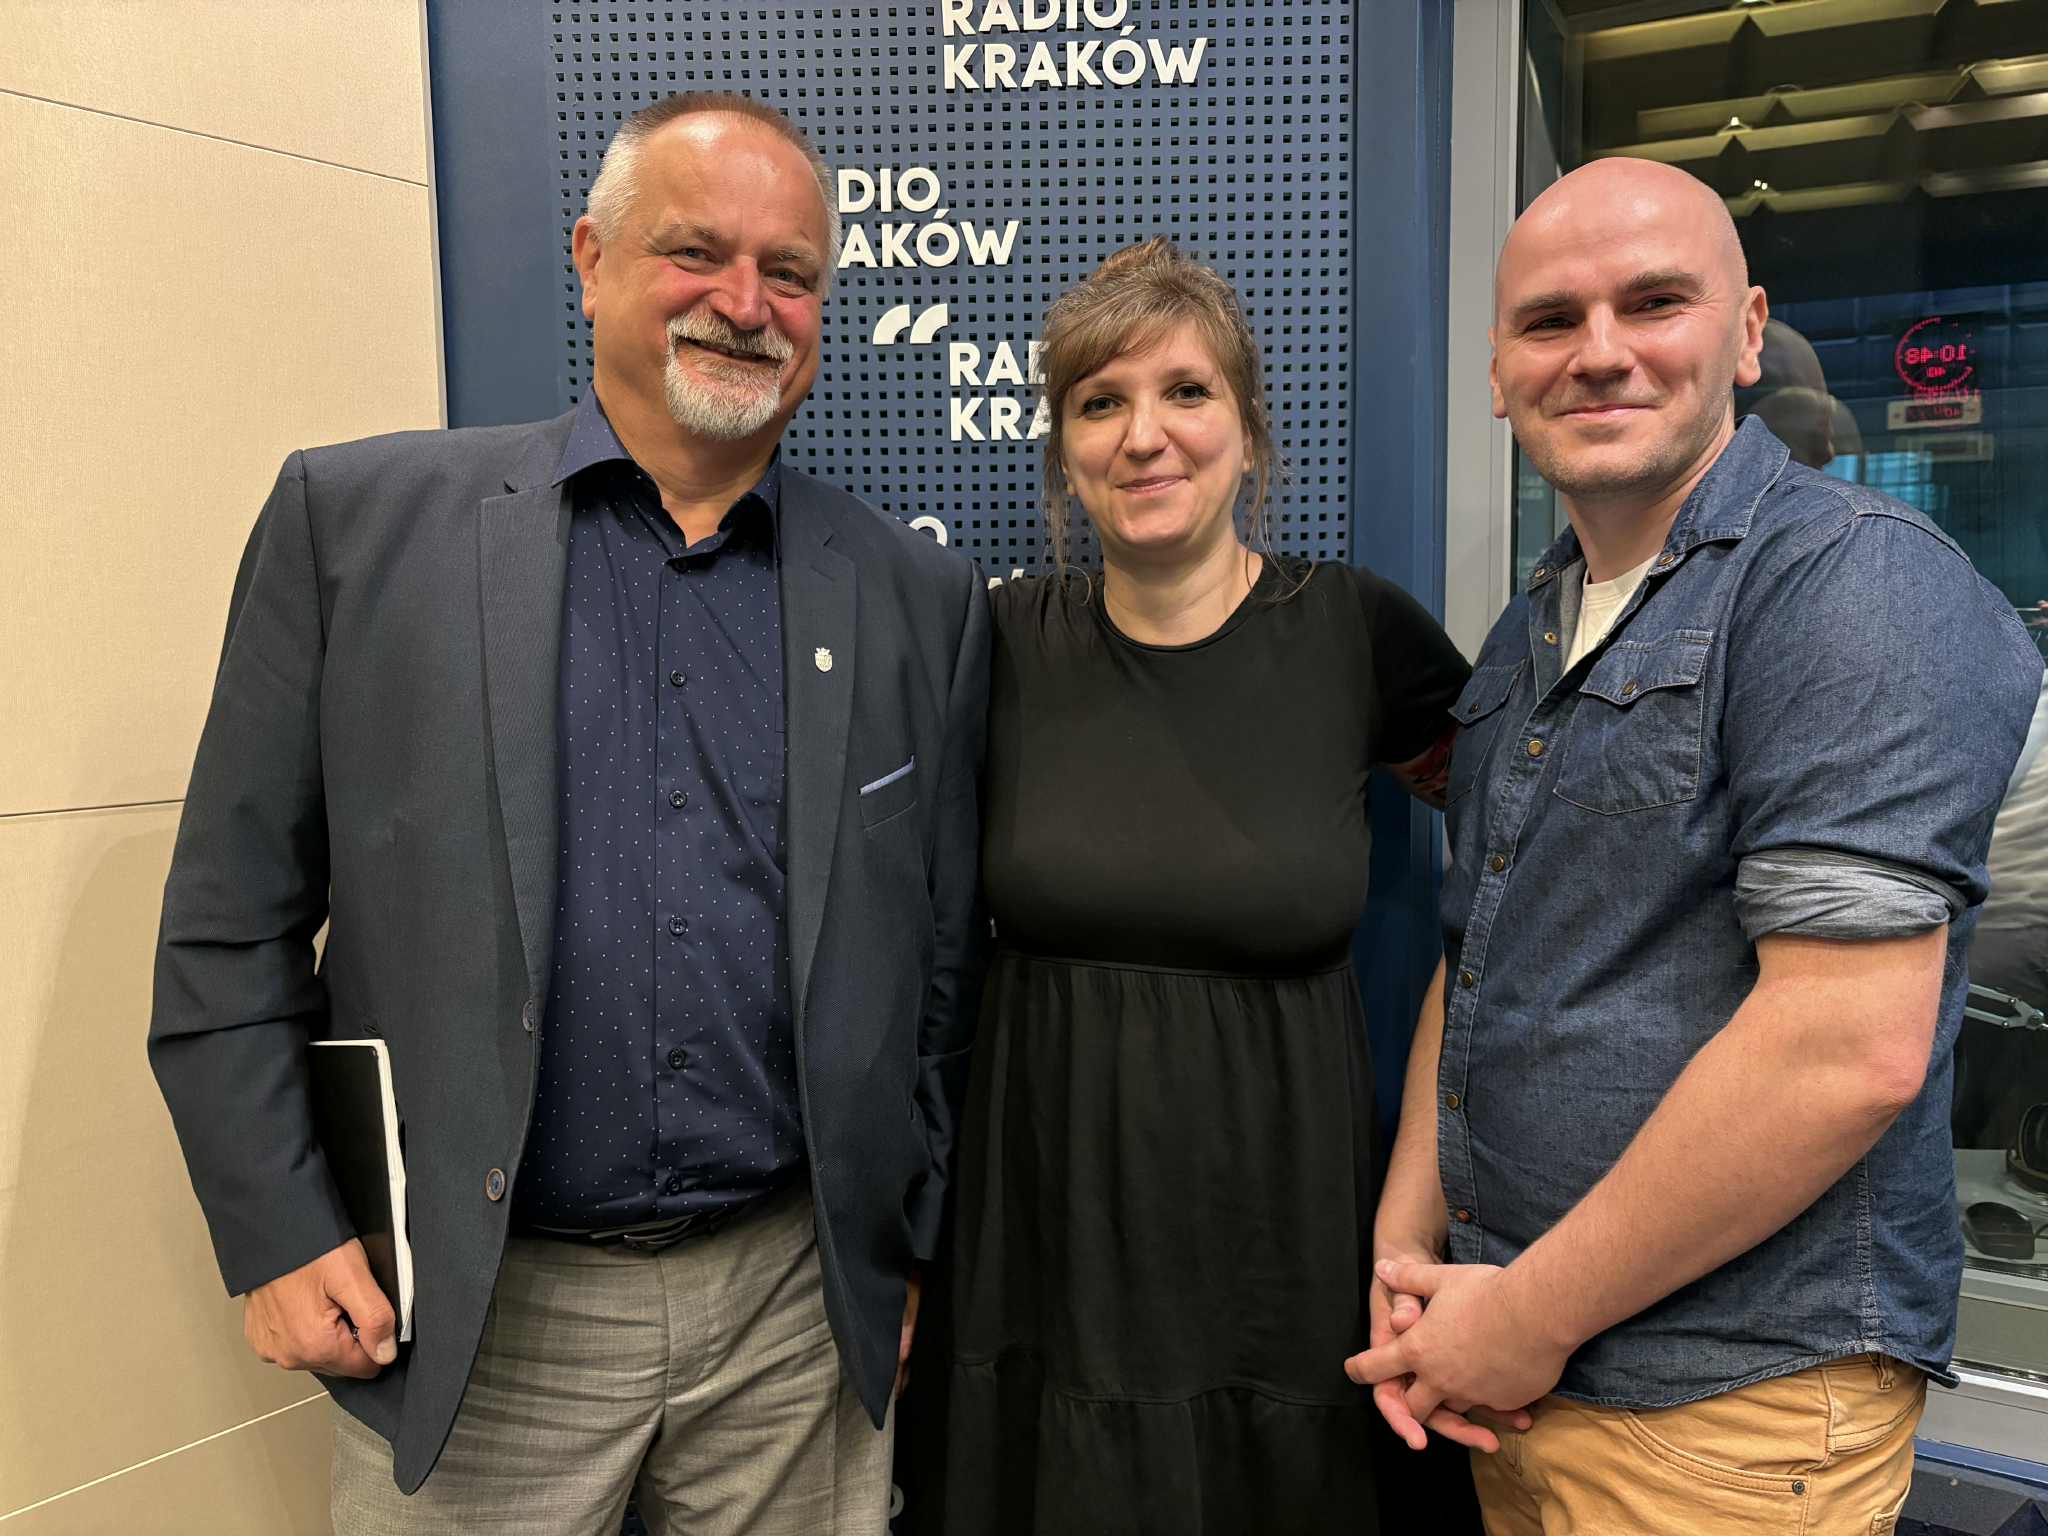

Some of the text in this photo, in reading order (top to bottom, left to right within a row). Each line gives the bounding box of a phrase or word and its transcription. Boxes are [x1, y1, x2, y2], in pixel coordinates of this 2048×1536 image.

[942, 0, 1128, 37] RADIO
[943, 25, 1208, 90] KRAKÓW
[837, 167, 941, 214] DIO
[837, 208, 1020, 269] AKÓW
[950, 396, 1053, 441] KRA
